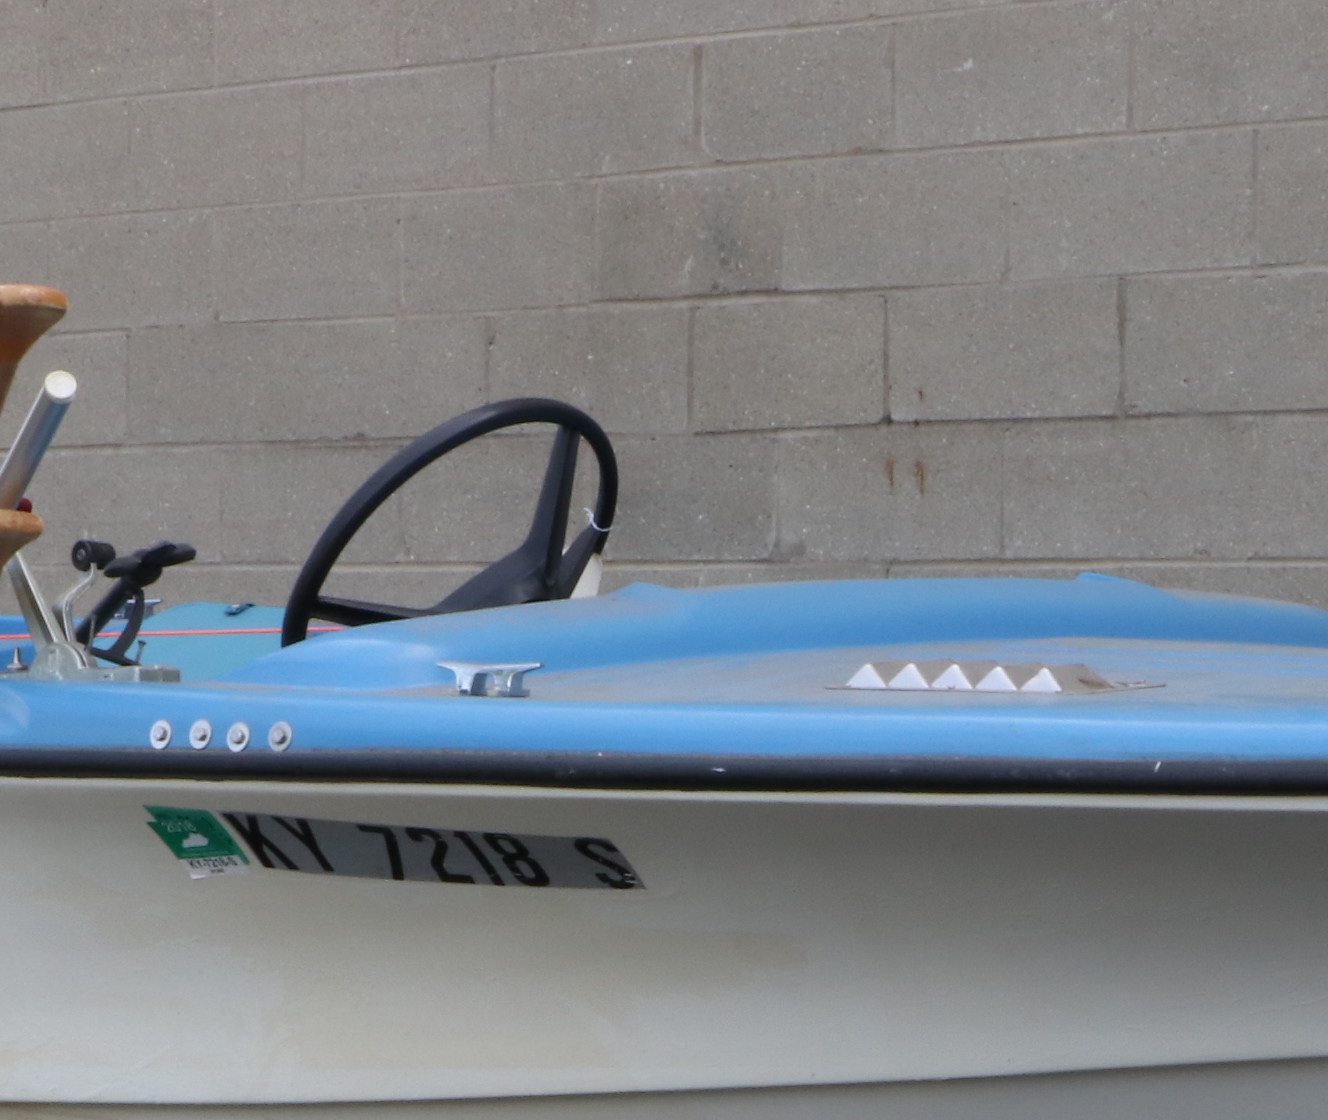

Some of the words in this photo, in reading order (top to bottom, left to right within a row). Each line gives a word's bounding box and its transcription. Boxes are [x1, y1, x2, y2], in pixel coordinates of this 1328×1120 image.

[223, 812, 336, 872] KY
[357, 824, 551, 887] 7218
[574, 836, 639, 889] S
